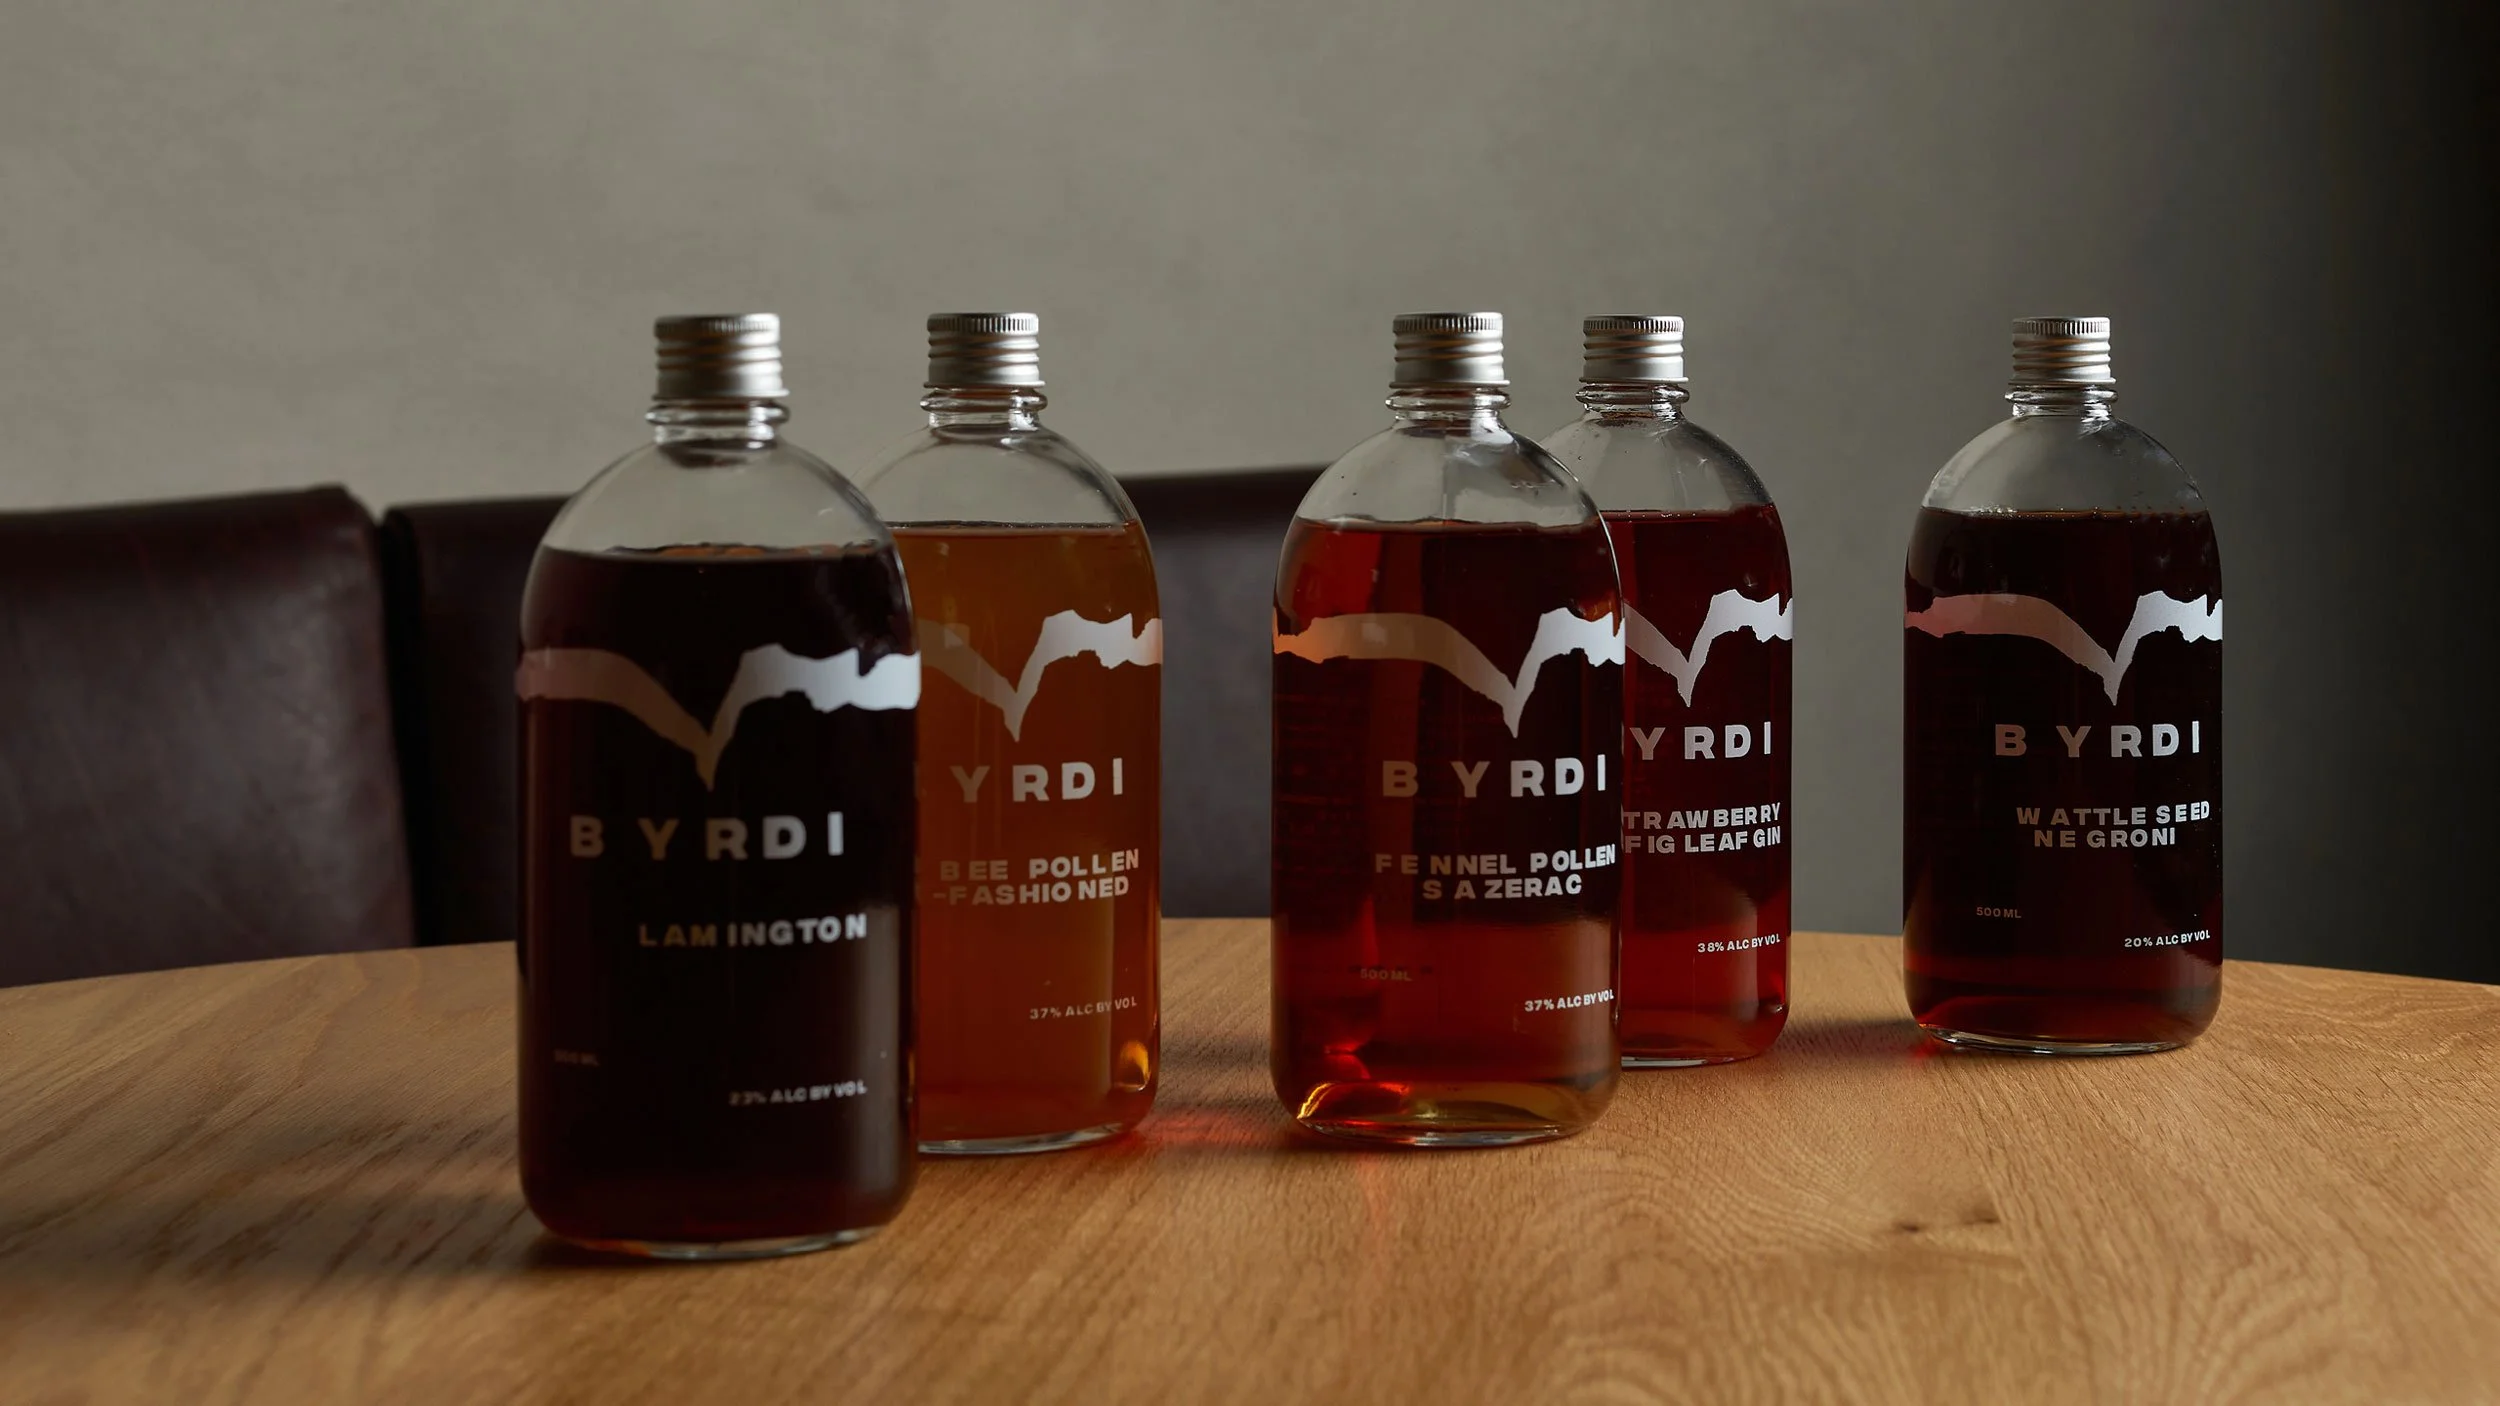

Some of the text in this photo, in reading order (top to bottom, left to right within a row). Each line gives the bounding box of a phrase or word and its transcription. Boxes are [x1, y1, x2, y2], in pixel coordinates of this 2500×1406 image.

[1629, 721, 1771, 760] YRDI
[1994, 720, 2200, 758] BYRDI
[950, 757, 1123, 803] YRDI
[1382, 753, 1607, 798] BYRDI
[1622, 802, 1781, 830] TRAWBERRY
[2016, 800, 2210, 826] WATTLE SEED
[569, 810, 844, 862] BYRDI
[1624, 825, 1781, 854] FIG LEAF GIN
[2033, 827, 2176, 848] NEGRONI
[940, 848, 1139, 881] BEE POLLEN
[1375, 843, 1616, 875] FENNEL POLLEN
[932, 875, 1129, 906] -FASHIONED
[1422, 874, 1583, 900] SAZERAC
[1976, 906, 2022, 919] 500 ML
[637, 912, 867, 948] LAMINGTON
[1697, 933, 1780, 953] 38% ALC BY VOL
[2124, 929, 2210, 948] 20% ALC BY VOL
[1029, 996, 1137, 1020] 37% ALC BY VOL
[1524, 988, 1614, 1012] 37% ALC BY VOL
[770, 1086, 807, 1104] ALC
[833, 1079, 868, 1098] VOL
